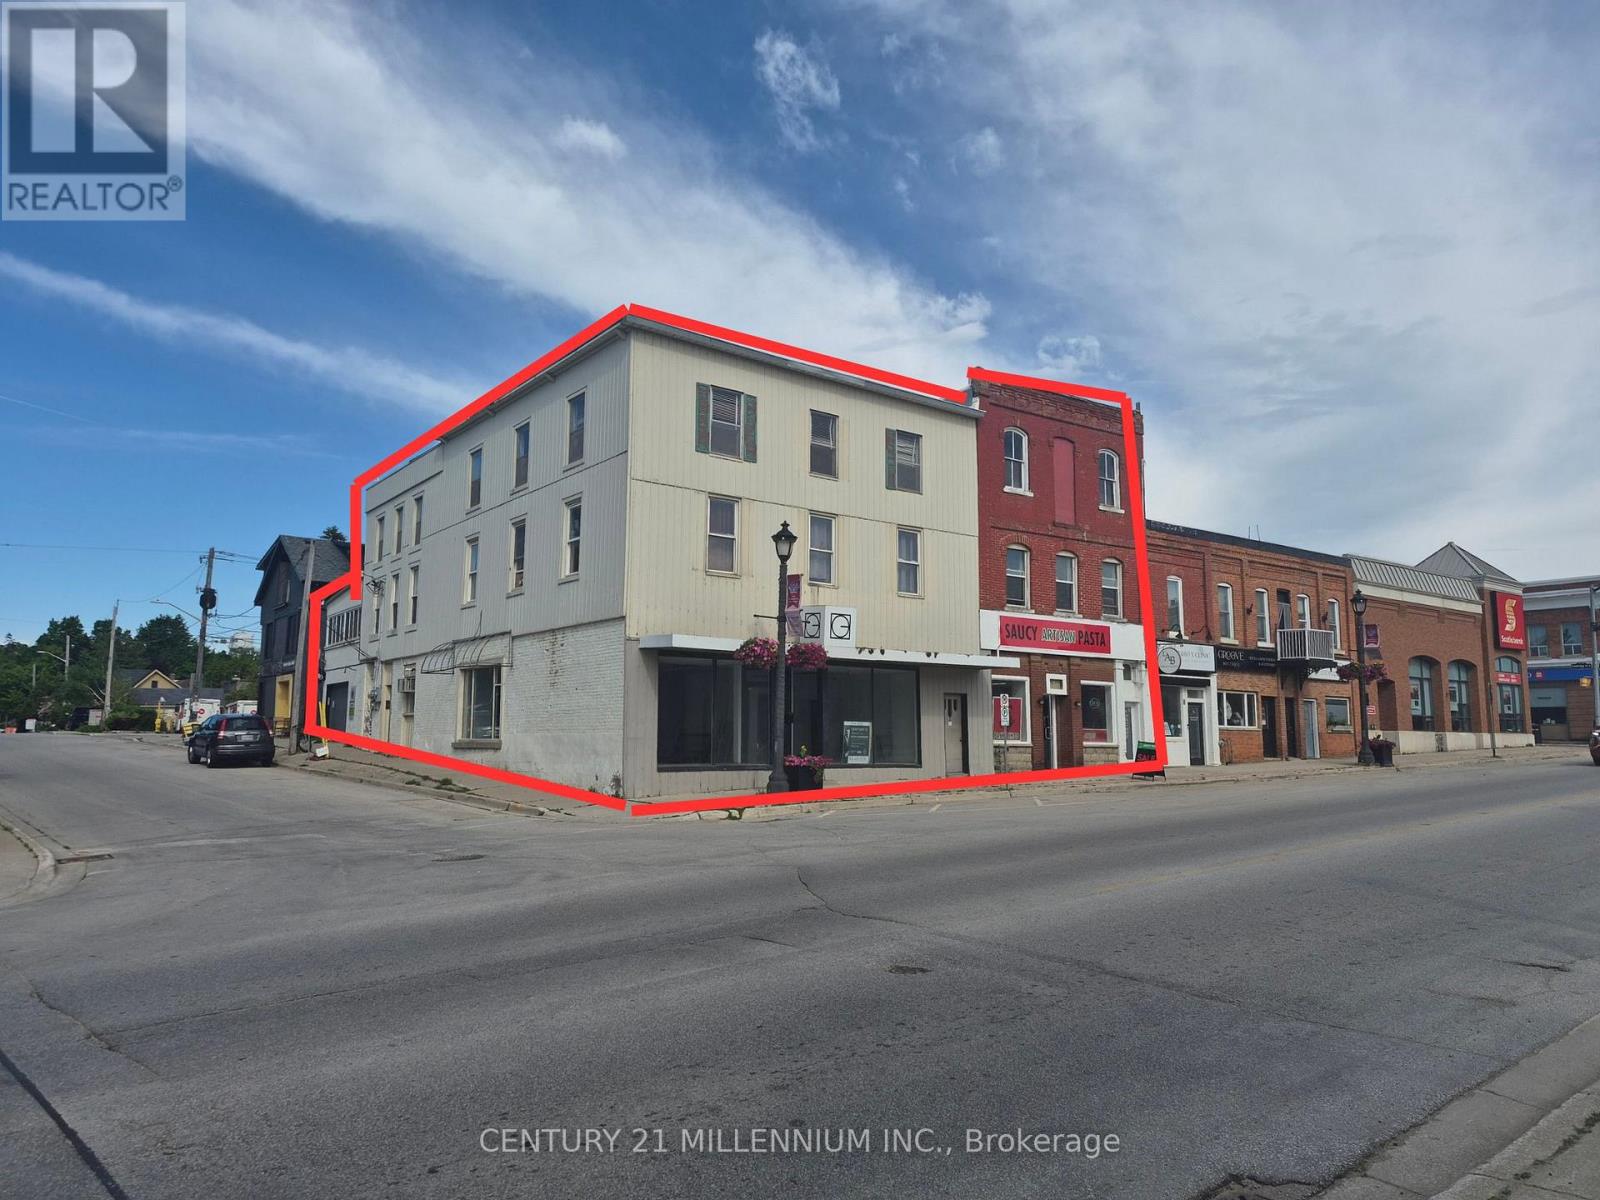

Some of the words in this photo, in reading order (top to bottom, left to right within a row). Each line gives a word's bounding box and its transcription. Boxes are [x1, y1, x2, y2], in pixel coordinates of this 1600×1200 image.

[1005, 623, 1038, 641] SAUCY
[1078, 630, 1106, 647] PASTA
[1217, 649, 1245, 661] GROOVE
